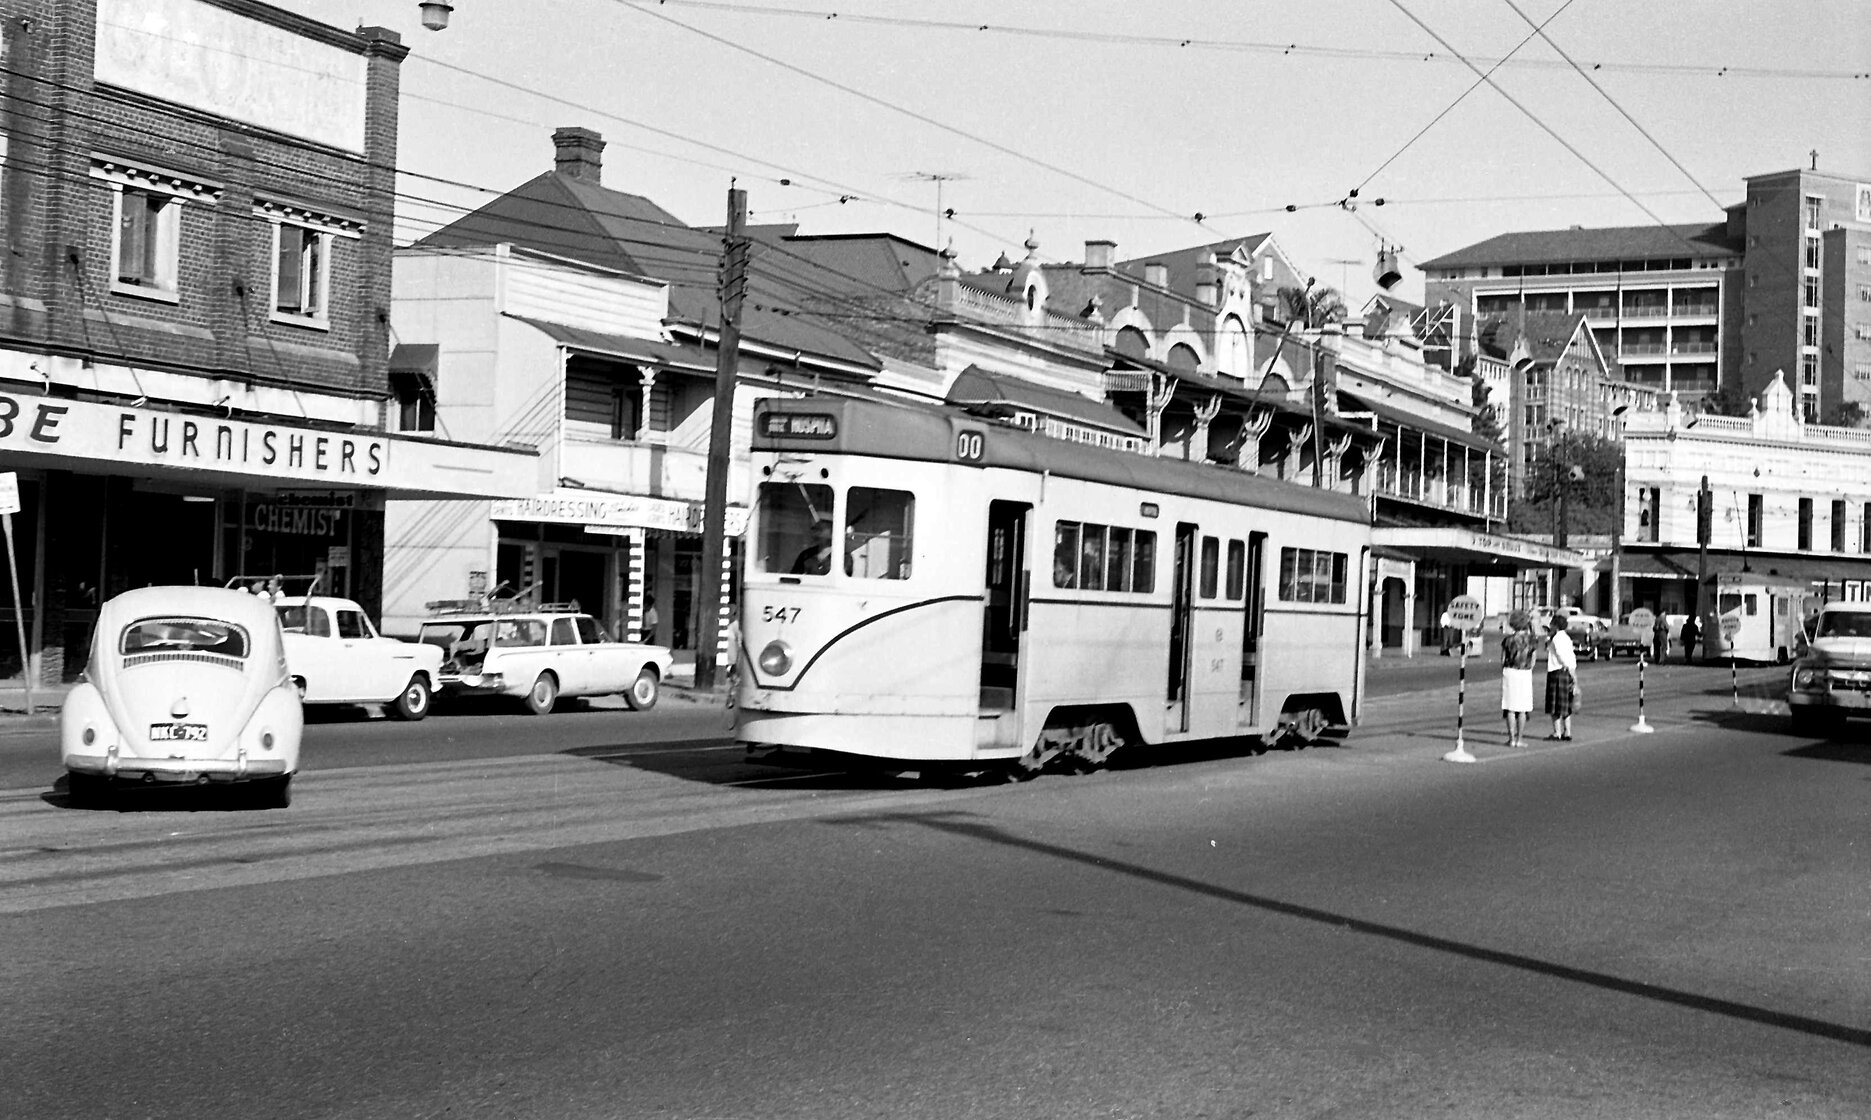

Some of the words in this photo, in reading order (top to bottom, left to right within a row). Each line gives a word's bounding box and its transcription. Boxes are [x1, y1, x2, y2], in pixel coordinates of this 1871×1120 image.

[119, 413, 381, 475] FURNISHERS
[959, 433, 981, 459] 00
[255, 503, 339, 536] CHEMIST
[519, 499, 607, 519] HAIRDRESSING
[762, 605, 801, 624] 547
[1451, 602, 1479, 610] SAFETY
